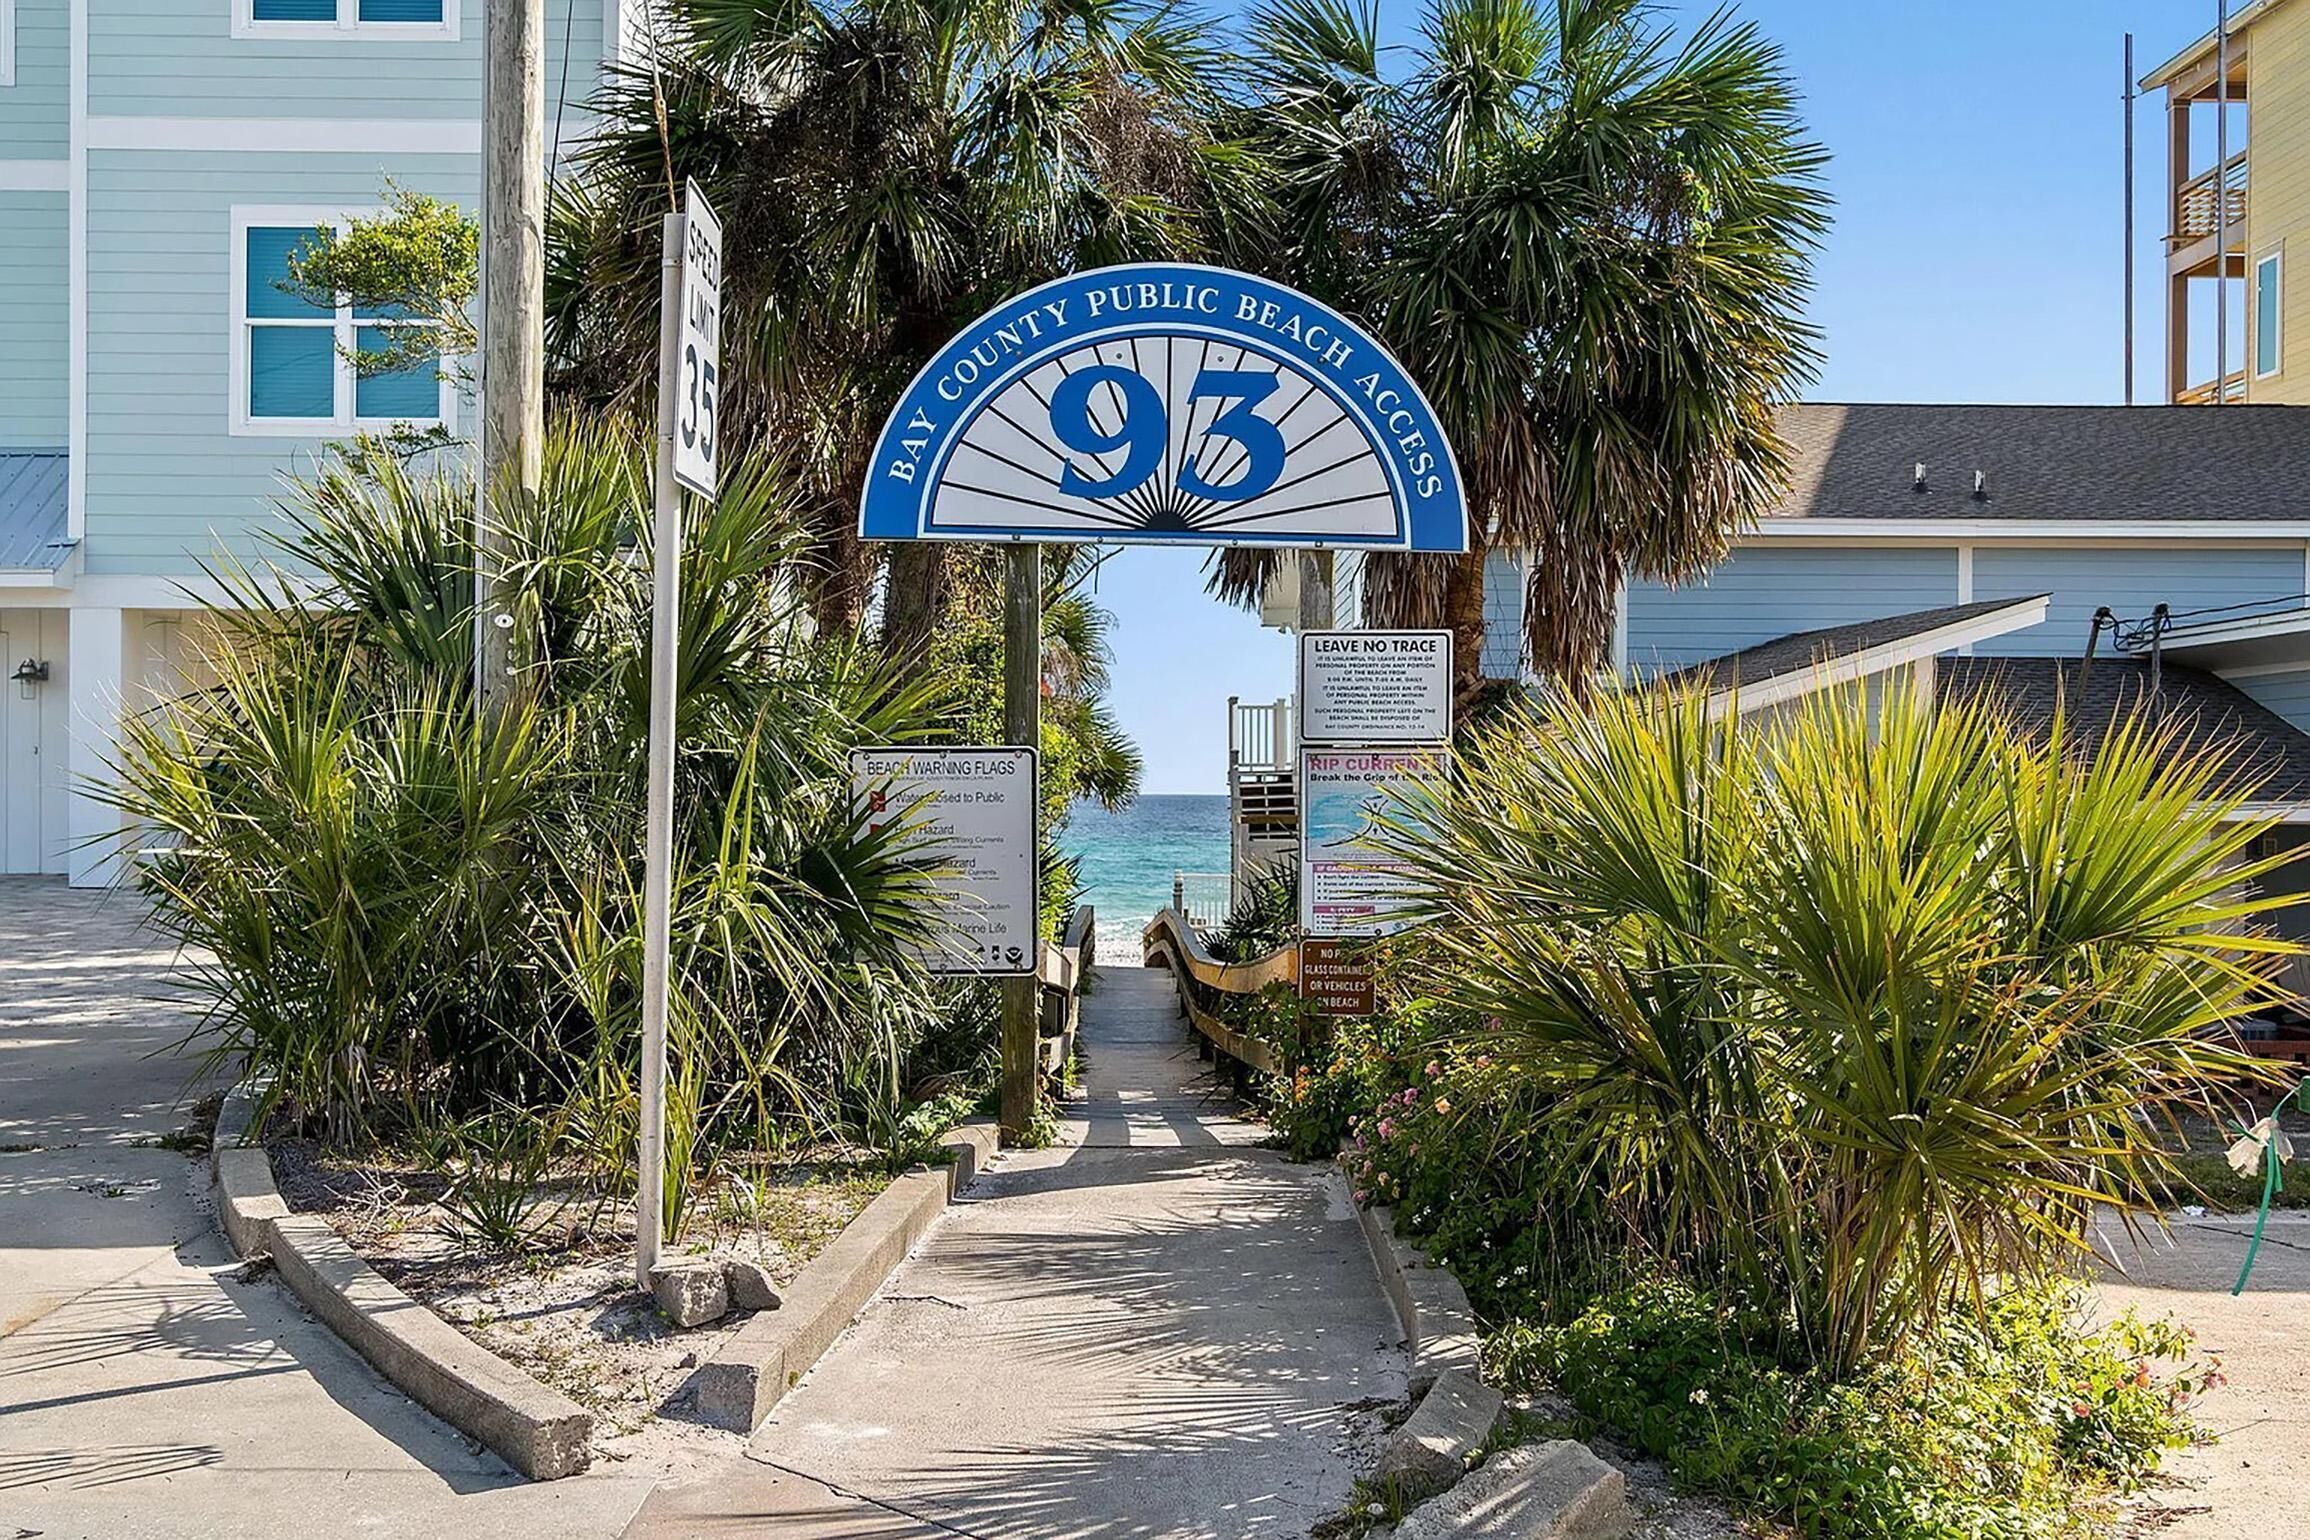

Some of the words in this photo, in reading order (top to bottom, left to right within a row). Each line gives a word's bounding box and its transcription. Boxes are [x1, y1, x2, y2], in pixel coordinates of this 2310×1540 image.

[689, 220, 718, 292] SPEED
[690, 284, 714, 346] LIMIT
[888, 406, 938, 485] BAY
[937, 298, 1069, 403] COUNTY
[1084, 283, 1219, 318] PUBLIC
[1234, 293, 1353, 371] BEACH
[1353, 371, 1443, 500] ACCESS
[681, 344, 715, 463] 35
[1049, 365, 1287, 501] 93
[1315, 640, 1358, 652] LEAVE
[1364, 640, 1387, 652] NO
[1392, 640, 1436, 652] TRACE
[913, 761, 971, 775] WARNING
[975, 760, 1015, 775] FLAGS
[1311, 758, 1339, 771] RIP
[1310, 774, 1340, 782] Break
[1344, 774, 1361, 782] the
[1364, 774, 1386, 784] Grip
[964, 793, 974, 803] to
[976, 792, 1005, 803] Public
[990, 923, 1008, 933] Life
[1321, 948, 1334, 958] NO
[1304, 964, 1328, 975] GLASS
[1310, 980, 1322, 990] OR
[1324, 981, 1367, 992] VEHICLES
[1330, 997, 1360, 1008] BEACH
